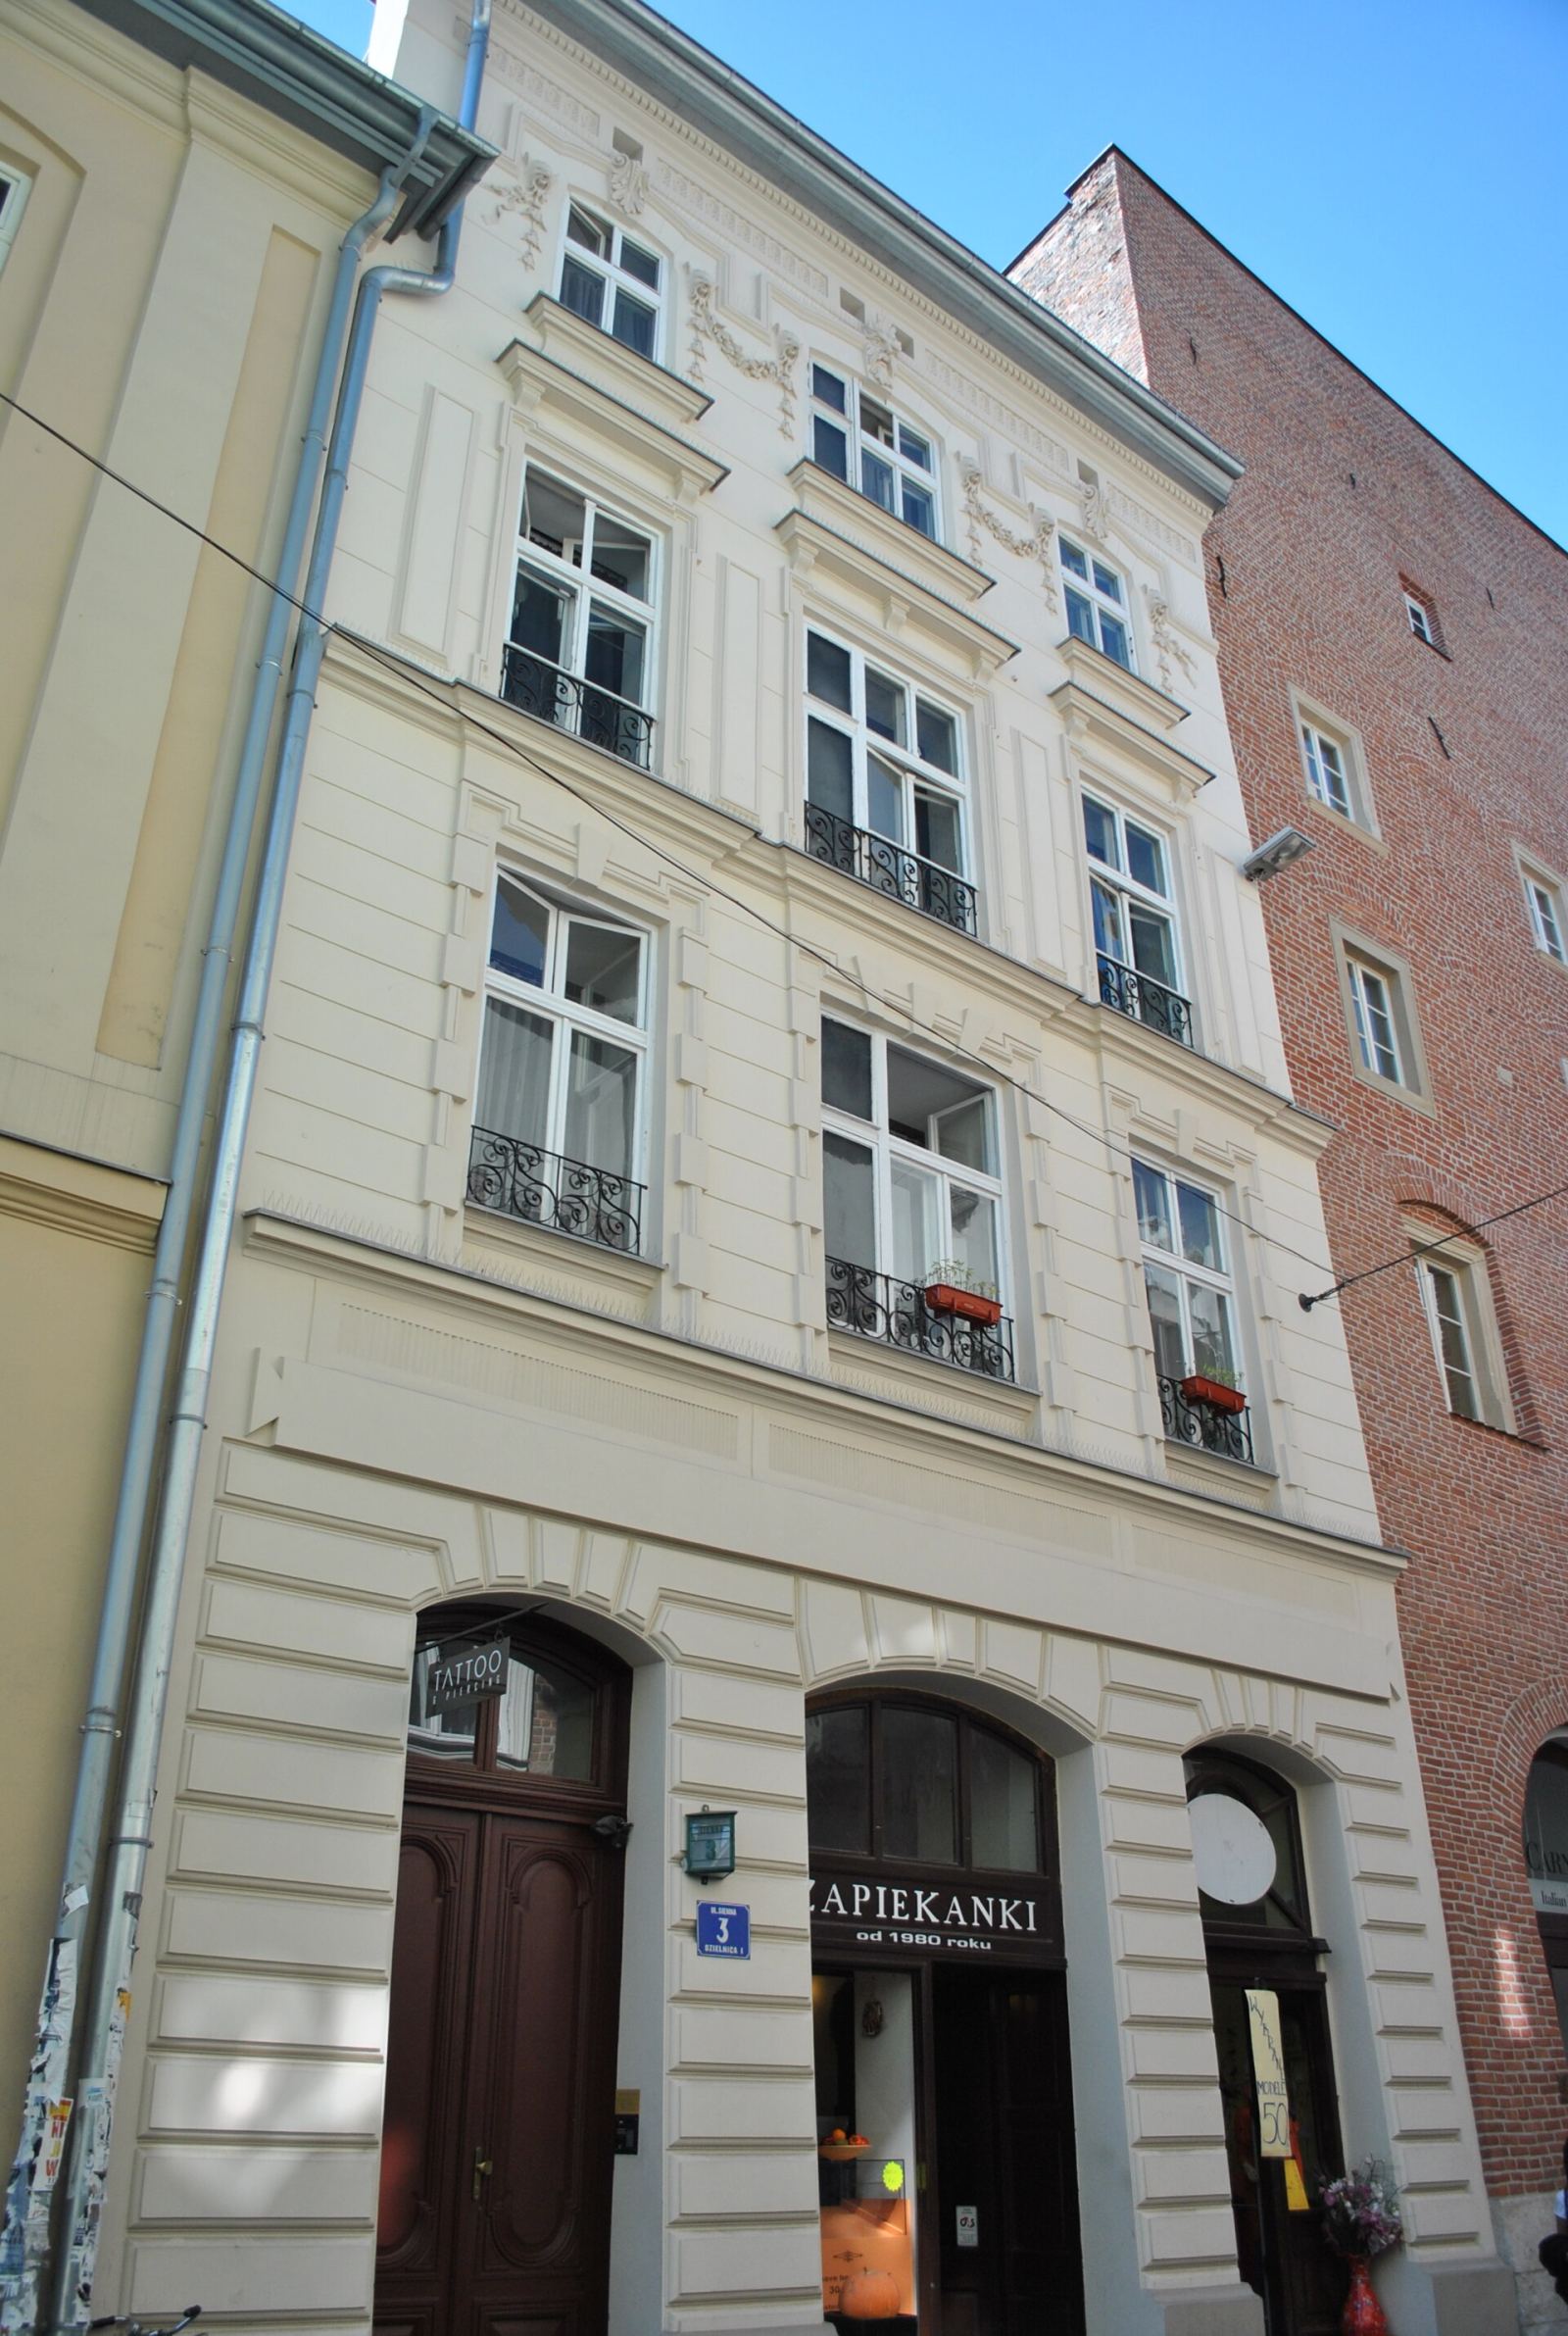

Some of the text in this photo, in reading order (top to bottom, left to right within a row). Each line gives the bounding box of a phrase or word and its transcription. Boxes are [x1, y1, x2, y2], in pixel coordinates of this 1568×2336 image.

[434, 1650, 502, 1692] TATTOO
[715, 1917, 730, 1944] 3
[857, 1930, 992, 1950] od 1980 roku
[705, 1944, 738, 1955] DZIELNICA
